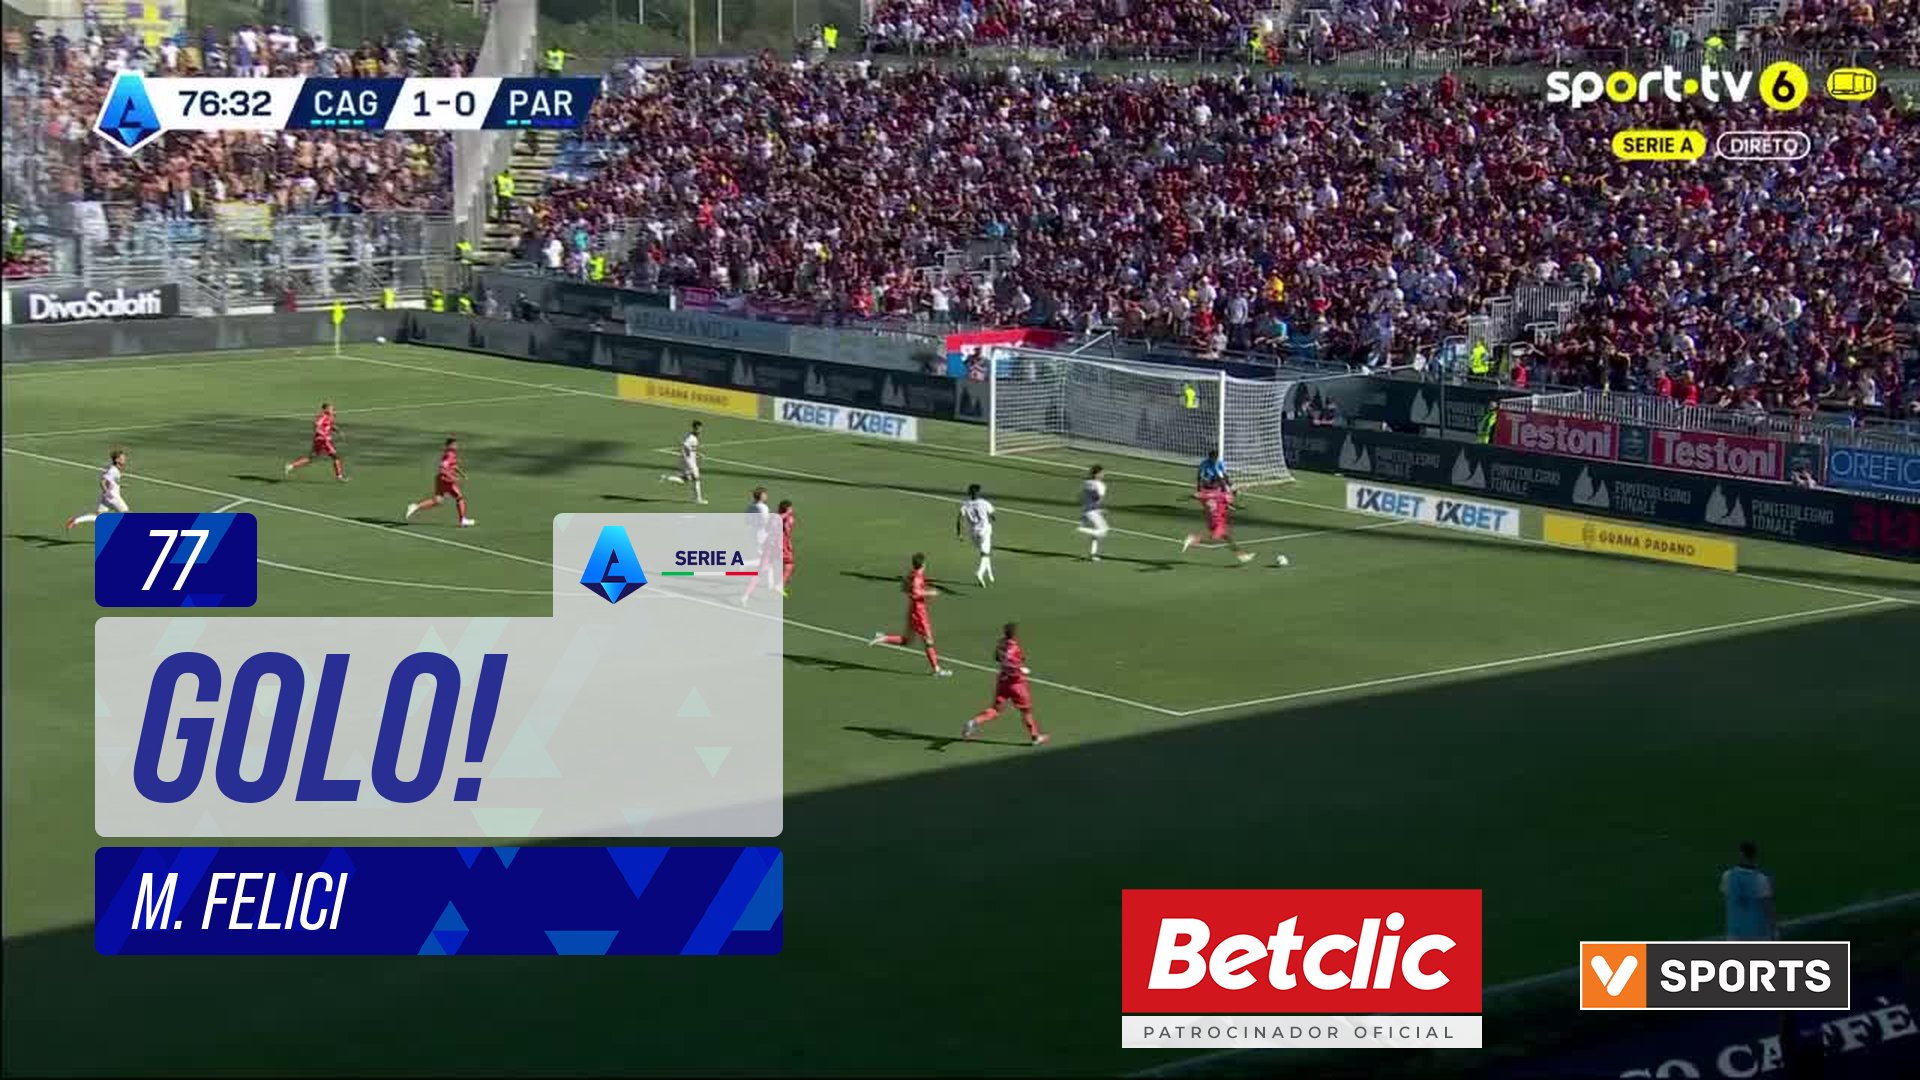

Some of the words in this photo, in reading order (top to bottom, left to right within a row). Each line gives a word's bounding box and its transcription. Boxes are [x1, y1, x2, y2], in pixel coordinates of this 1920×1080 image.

[782, 402, 839, 426] 1XBET
[846, 410, 907, 435] 1XBET
[1506, 413, 1612, 459] Testoni
[1657, 431, 1777, 478] Testoni
[1356, 487, 1426, 517] 1XBET
[1435, 500, 1508, 531] 1XBET
[1598, 530, 1640, 550] GRANA
[1644, 535, 1696, 557] PADANO
